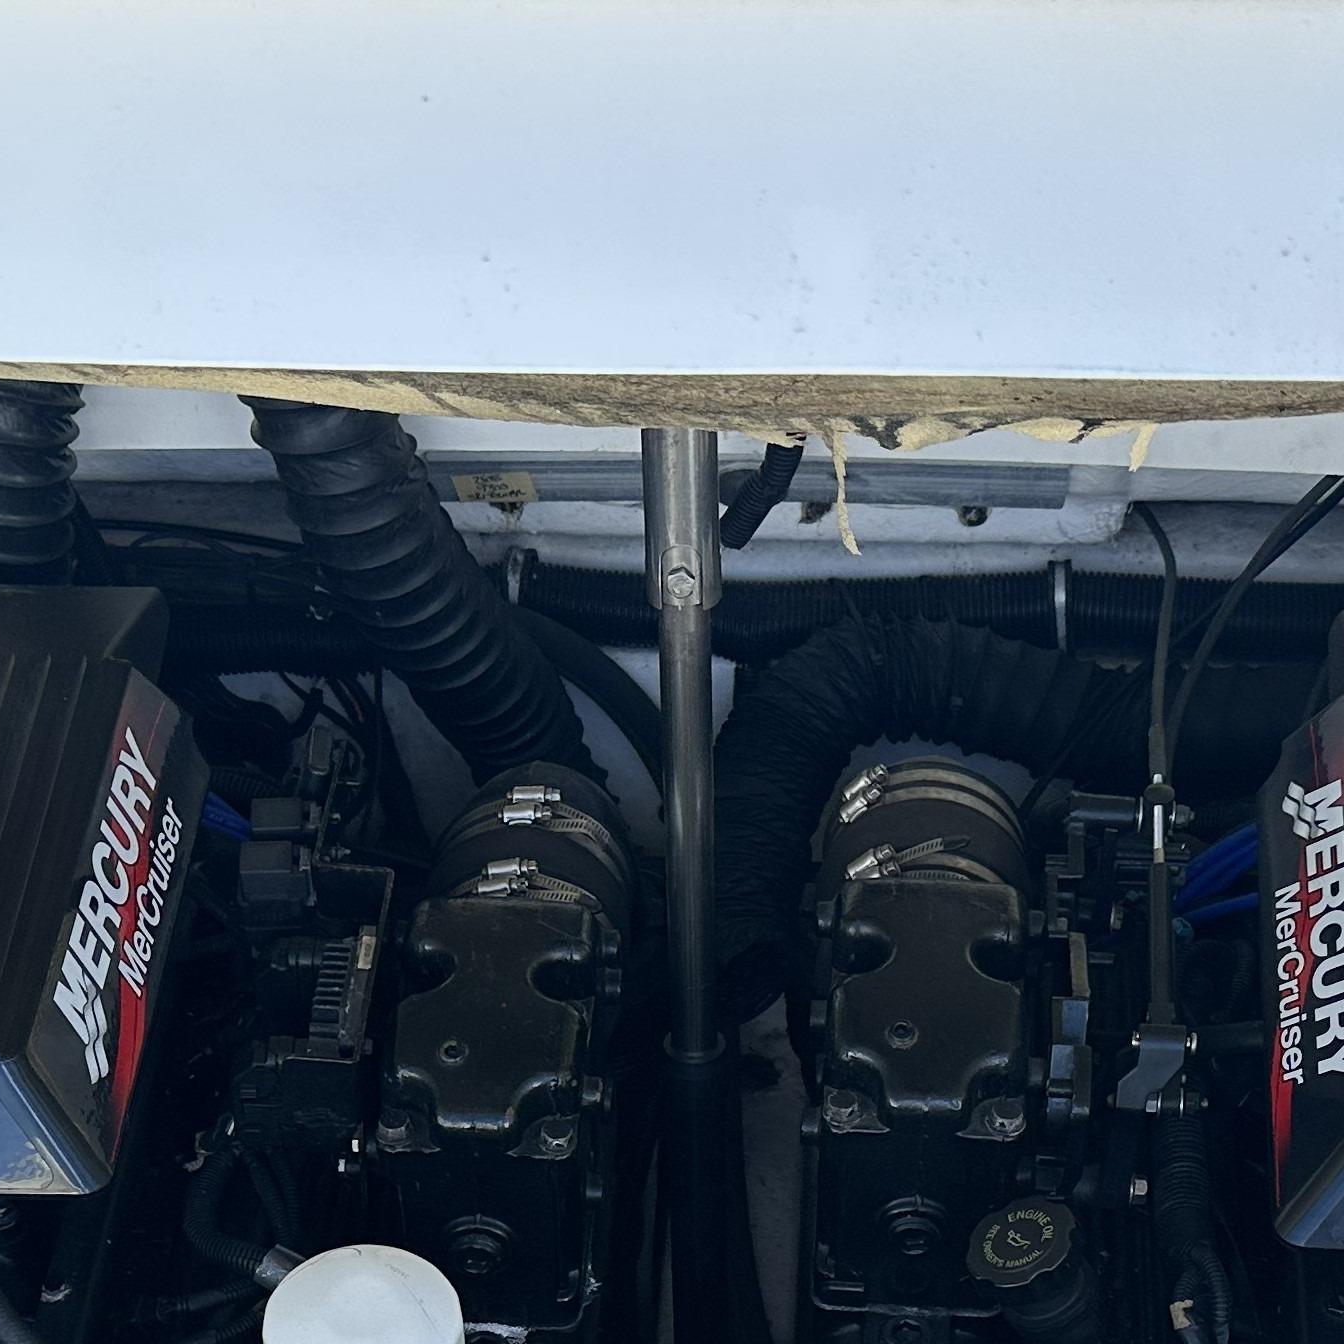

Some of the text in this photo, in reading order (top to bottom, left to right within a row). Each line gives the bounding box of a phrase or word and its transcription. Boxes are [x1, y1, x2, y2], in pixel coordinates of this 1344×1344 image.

[53, 727, 157, 1047] MERCURY
[118, 796, 184, 999] MerCruiser
[1274, 881, 1307, 1086] MerCruiser
[1004, 1249, 1045, 1269] MANUAL
[1007, 1208, 1054, 1243] ENGINE OIL
